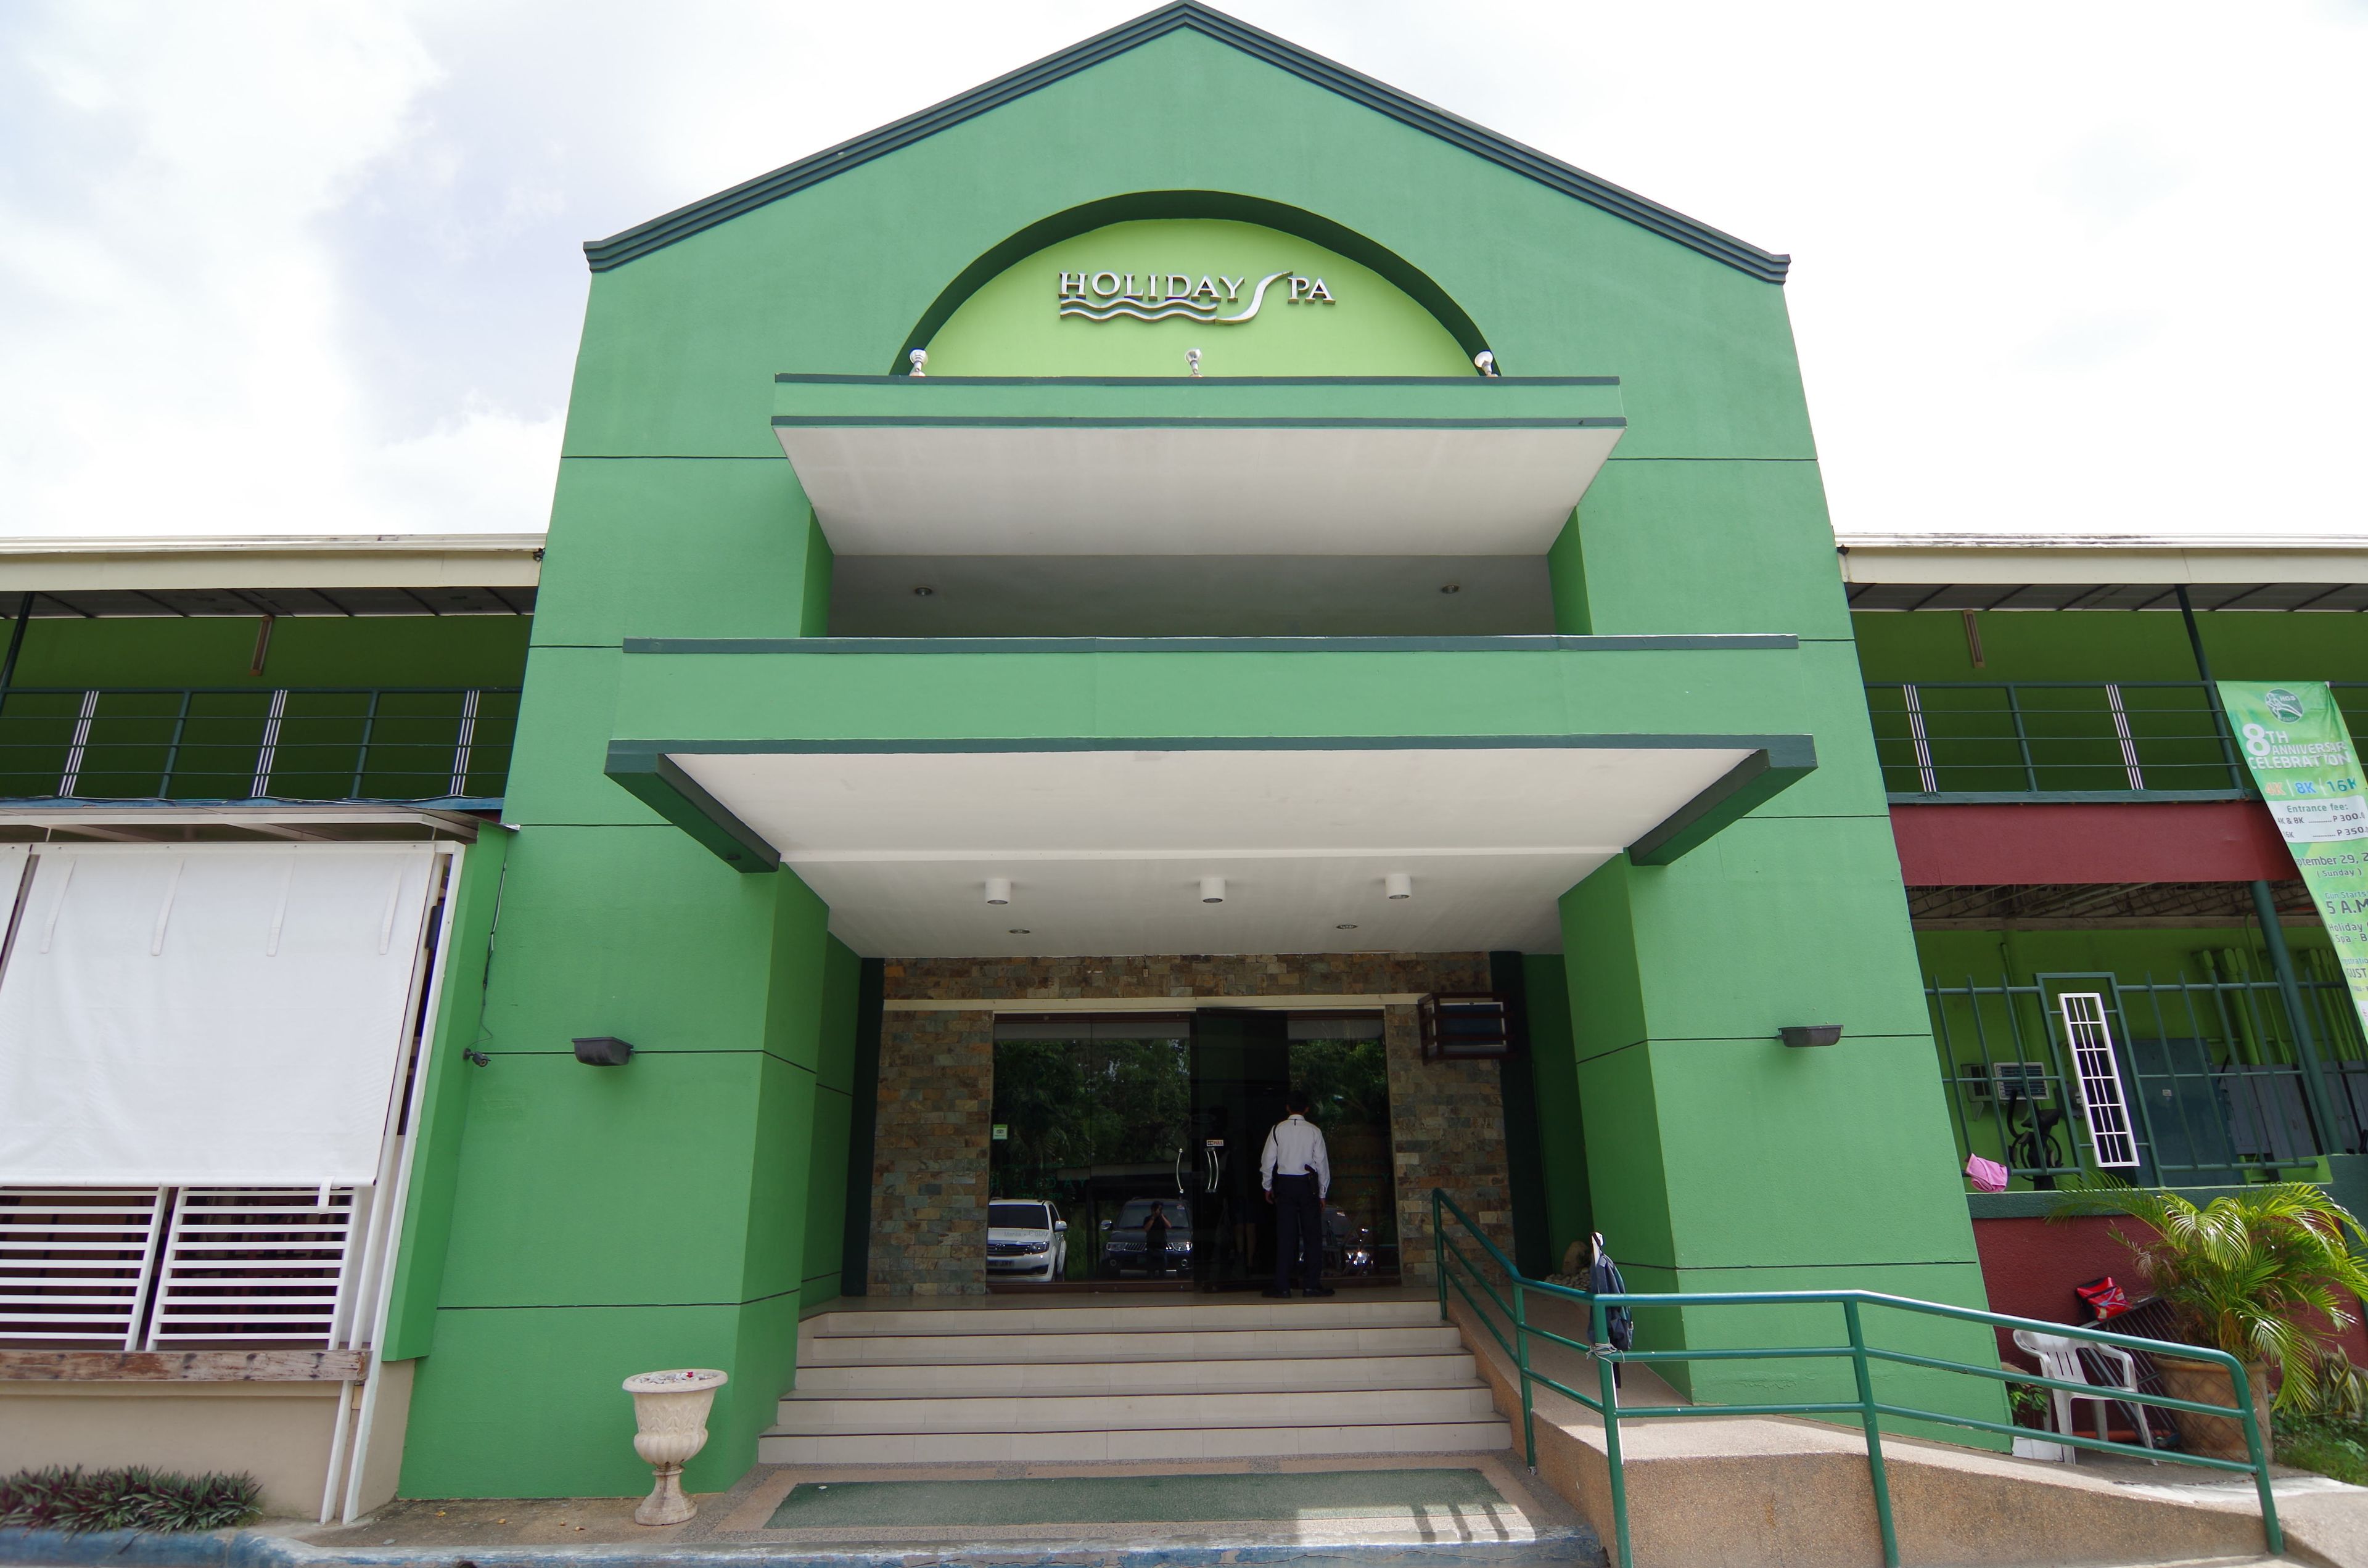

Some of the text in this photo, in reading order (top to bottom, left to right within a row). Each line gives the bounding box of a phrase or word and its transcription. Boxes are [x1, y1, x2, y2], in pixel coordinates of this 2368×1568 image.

[1058, 271, 1245, 303] HOLIDAY
[2265, 777, 2358, 796] 4K 8K 16K
[2287, 803, 2348, 813] Entrance fee:
[2339, 854, 2359, 864] 29,
[2322, 869, 2354, 877] Sunday
[2325, 901, 2337, 914] 5
[2329, 922, 2363, 933] Holiday
[2335, 934, 2352, 944] Spa
